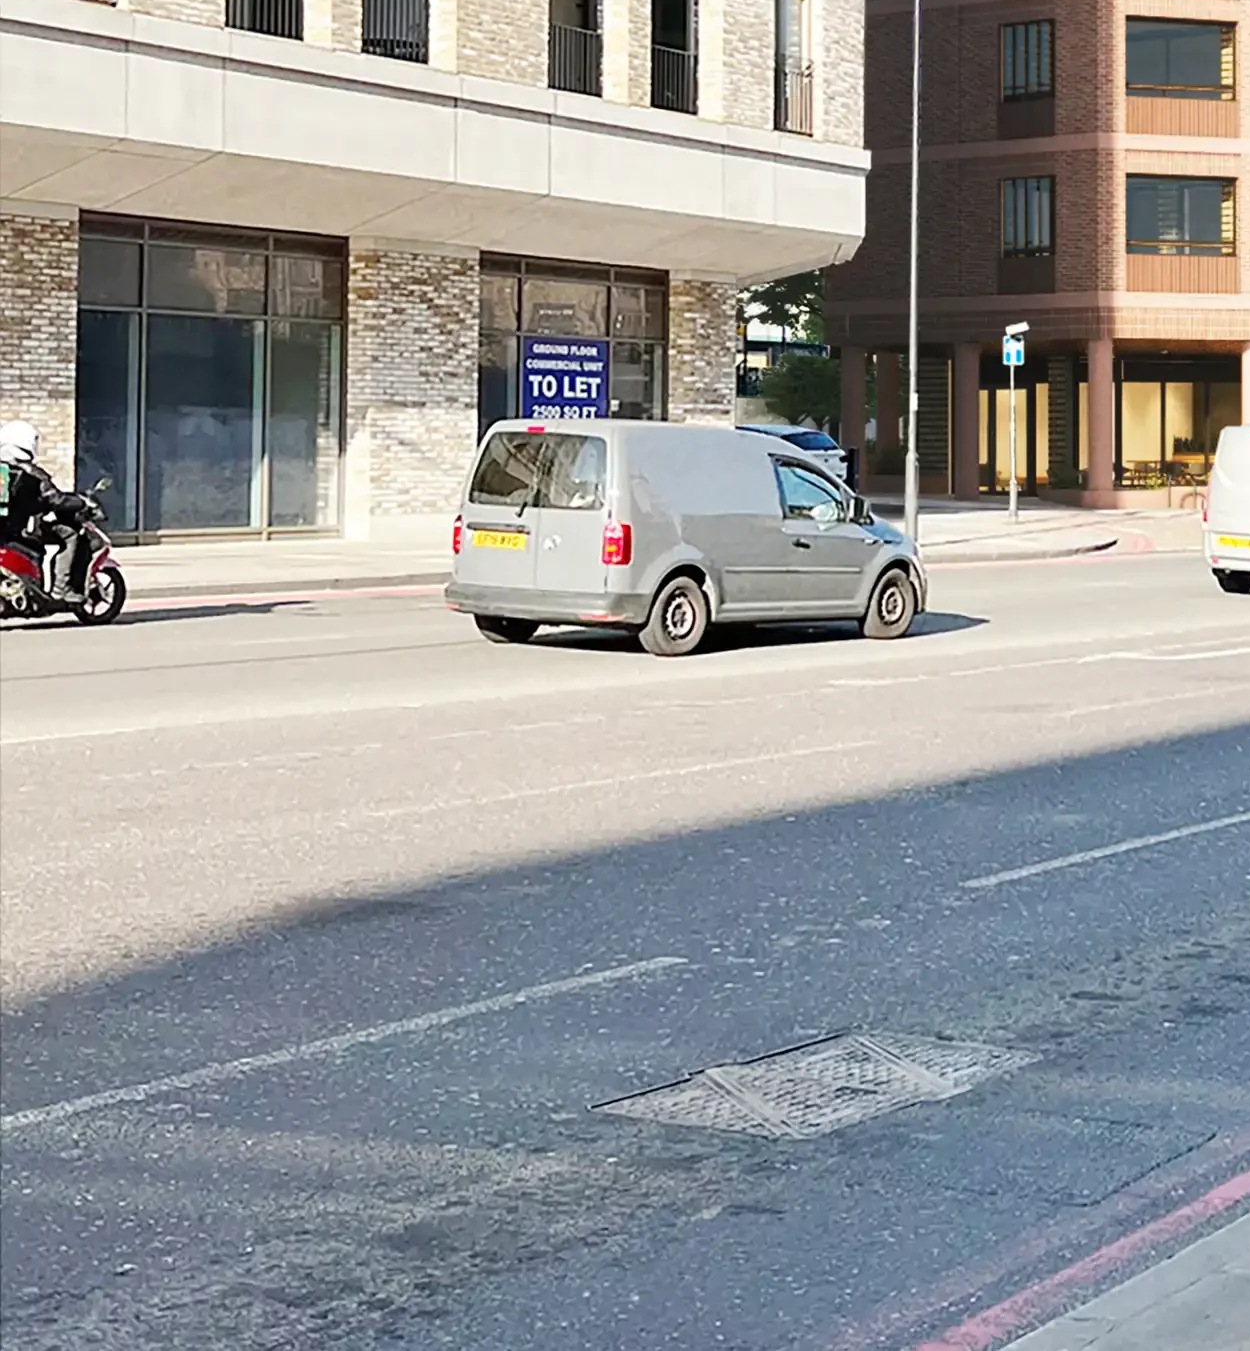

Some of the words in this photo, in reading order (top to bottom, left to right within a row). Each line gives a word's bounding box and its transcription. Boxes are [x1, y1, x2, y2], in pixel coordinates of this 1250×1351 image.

[532, 343, 569, 355] GROUND
[570, 345, 598, 356] FLOOR
[526, 359, 581, 371] COMMERCIAL
[583, 361, 604, 371] UNIT
[528, 375, 558, 398] TO
[564, 376, 601, 398] LET
[532, 405, 561, 419] 2500
[582, 406, 597, 419] FT
